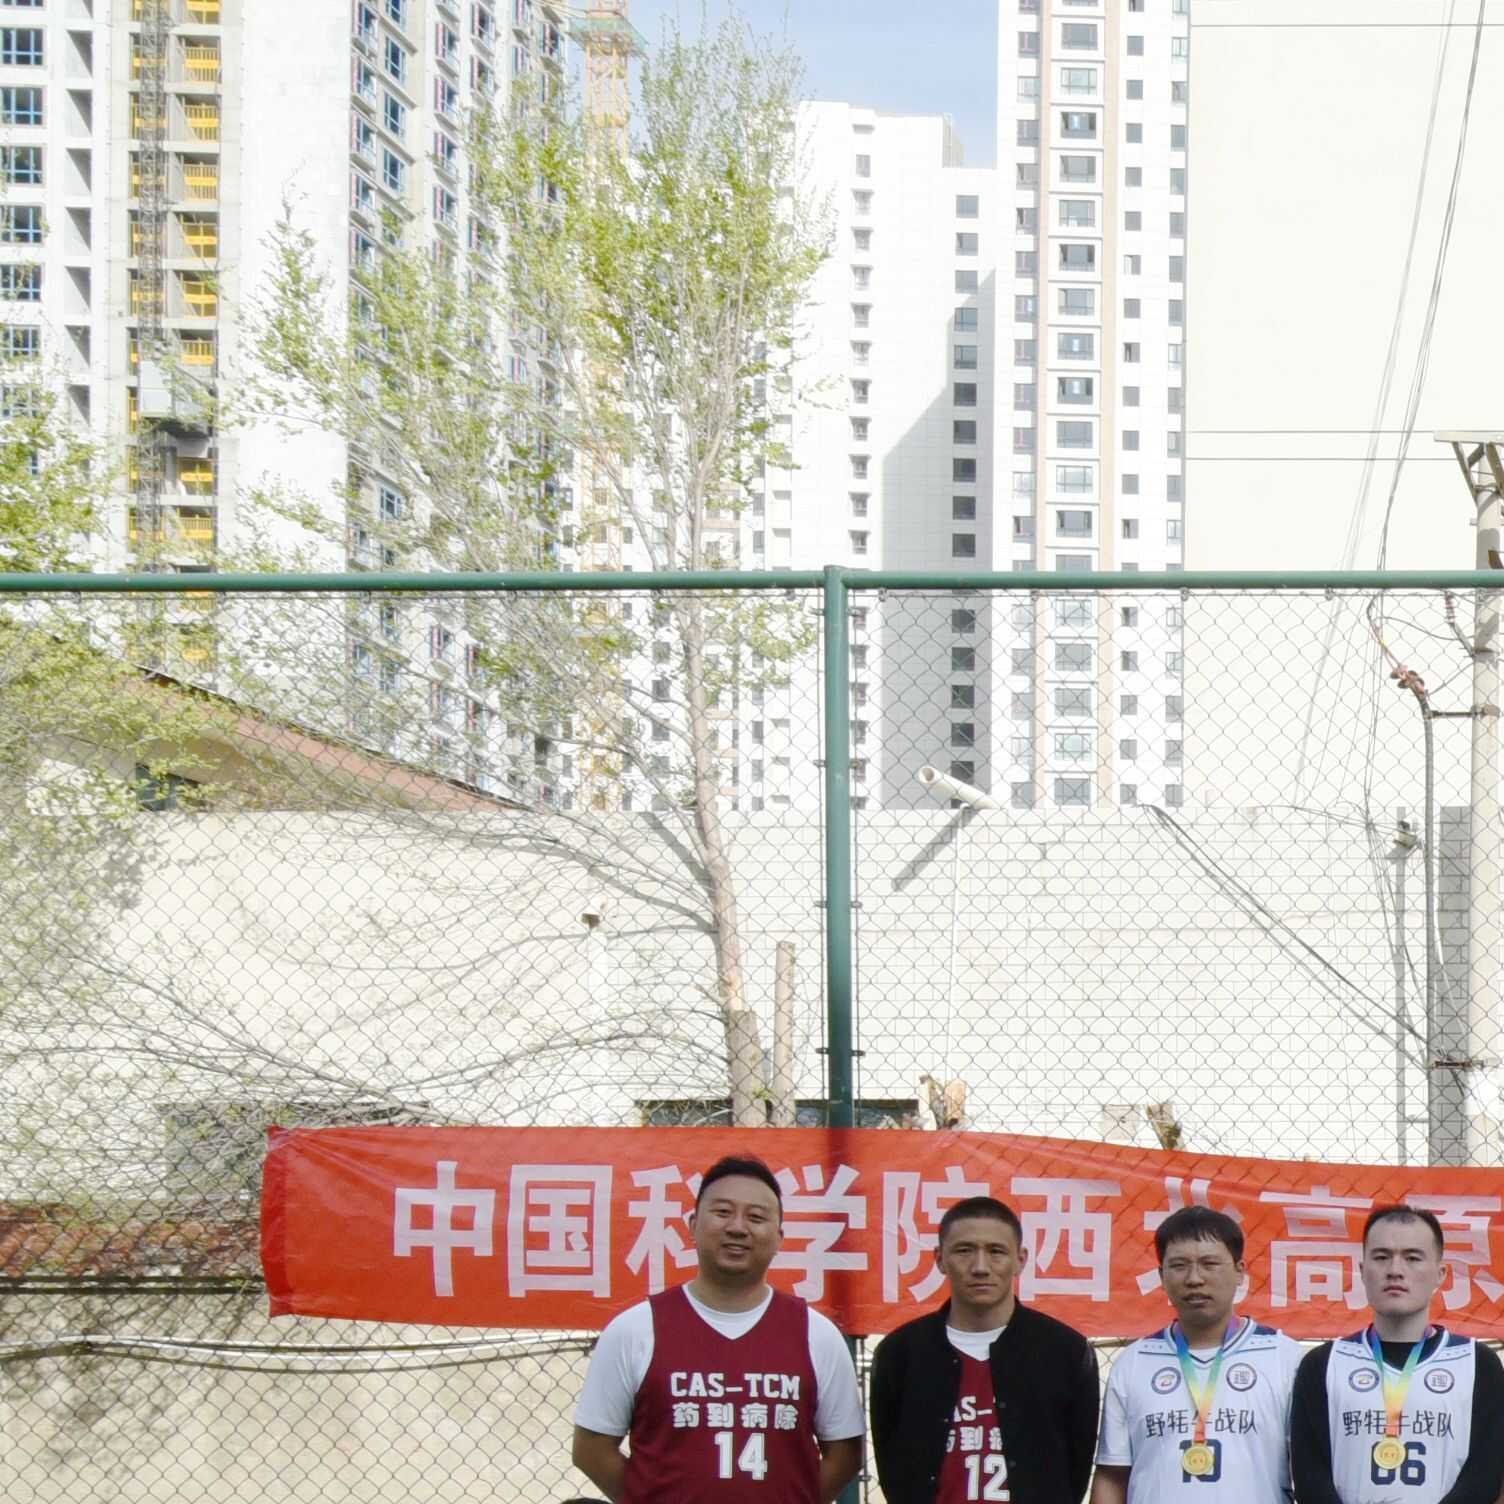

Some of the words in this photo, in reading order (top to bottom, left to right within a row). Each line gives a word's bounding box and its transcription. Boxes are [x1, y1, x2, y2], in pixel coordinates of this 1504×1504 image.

[670, 1372, 800, 1398] CAS-TCM
[714, 1431, 768, 1481] 14
[965, 1453, 1010, 1502] 12
